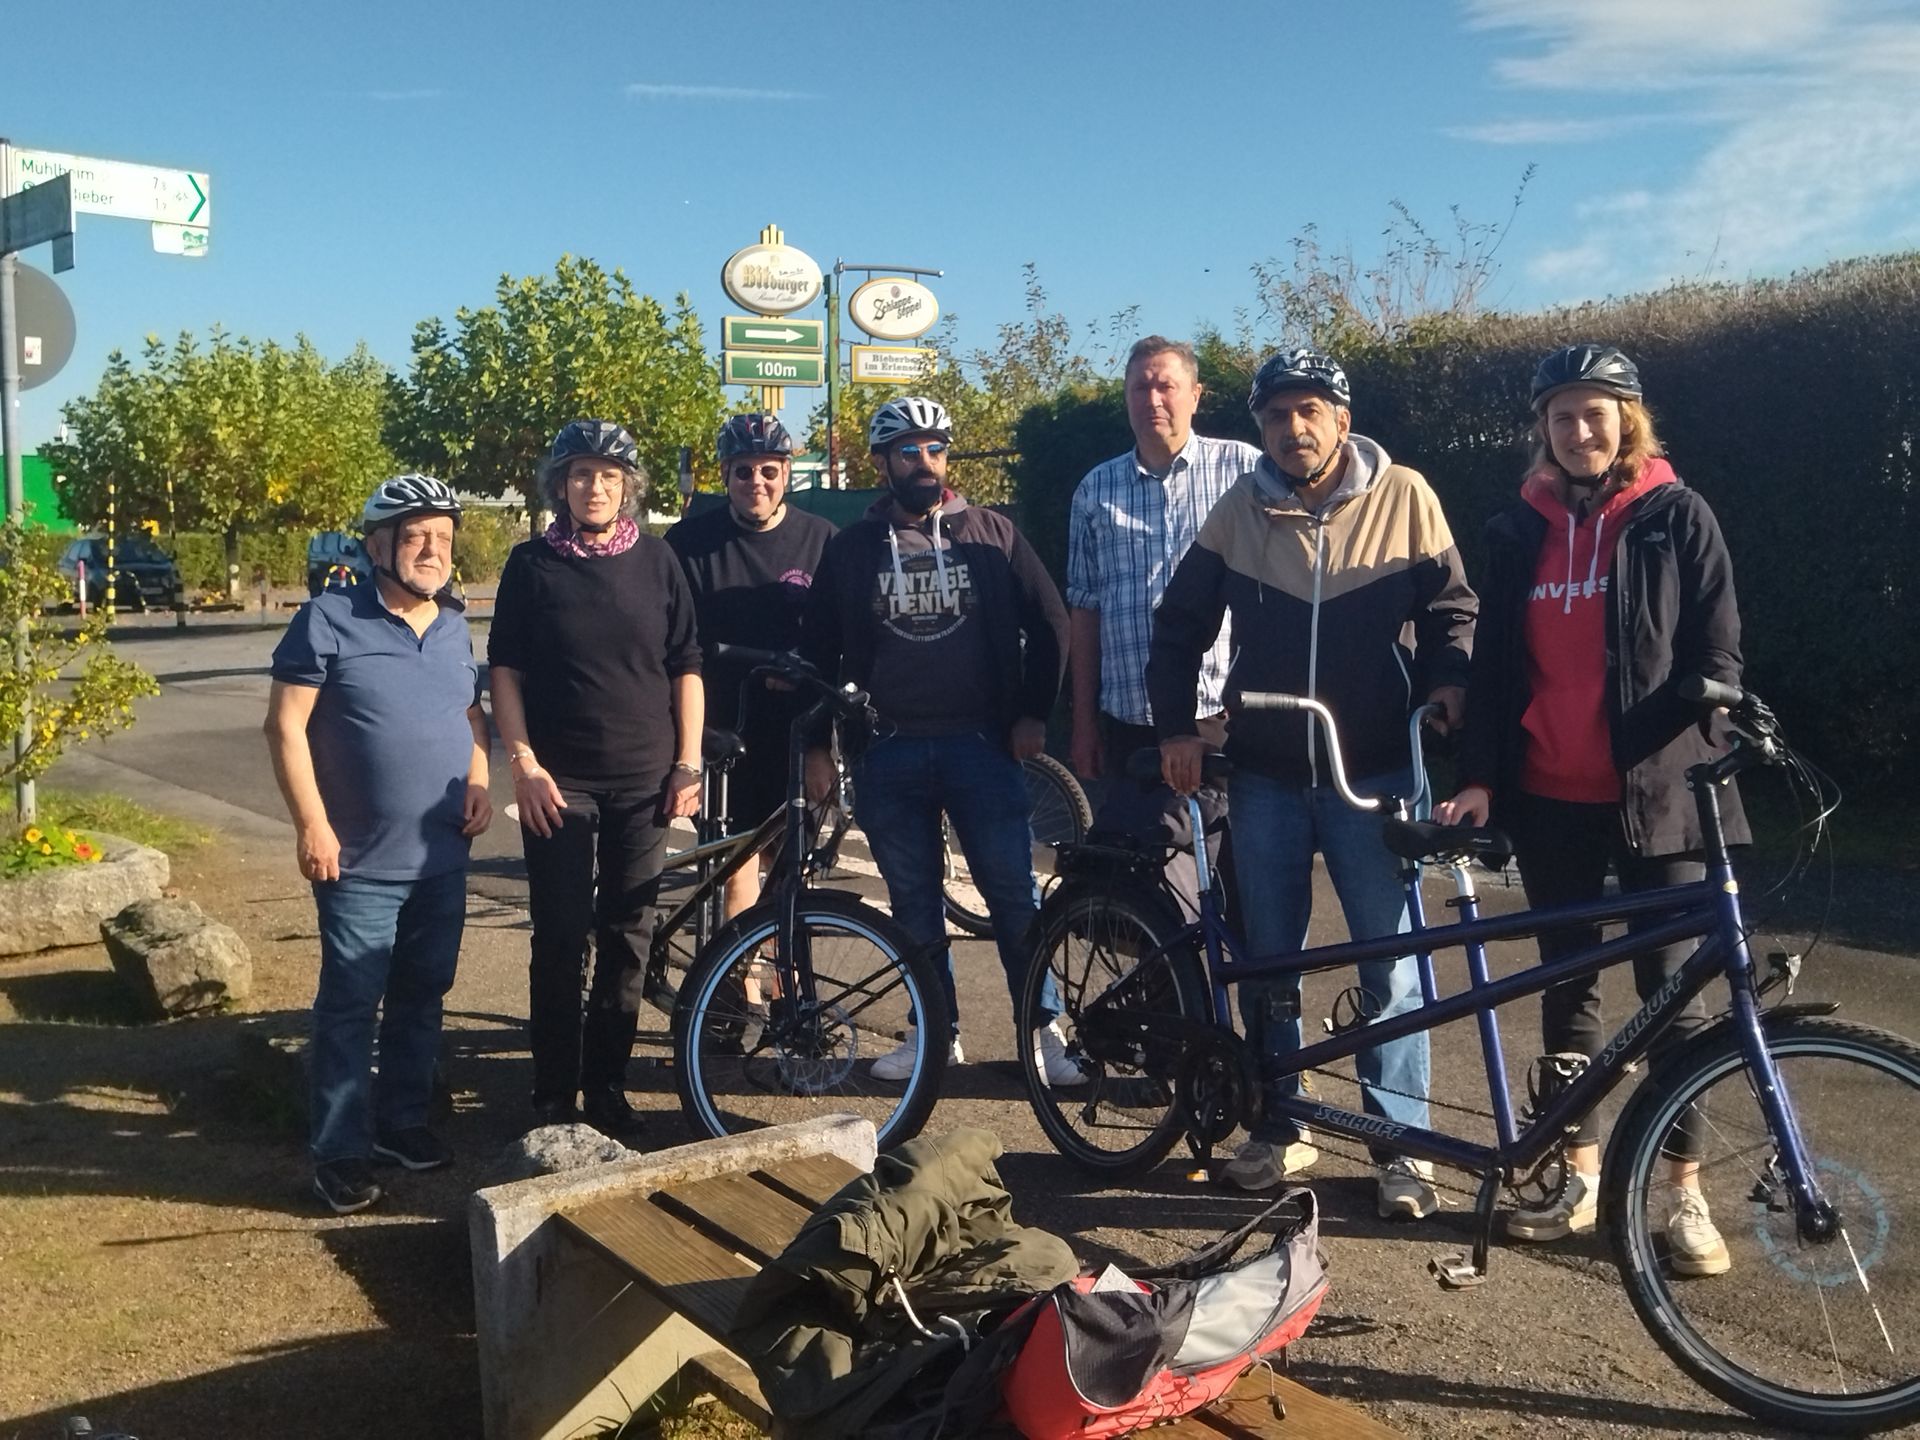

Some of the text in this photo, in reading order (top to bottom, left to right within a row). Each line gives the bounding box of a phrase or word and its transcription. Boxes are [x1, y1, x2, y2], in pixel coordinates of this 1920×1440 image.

[741, 264, 809, 295] Bitburger
[756, 361, 797, 377] 100m
[1528, 576, 1609, 601] NVERS
[1602, 967, 1683, 1066] SCHAUFF
[1315, 1104, 1407, 1140] SCHAUFF
